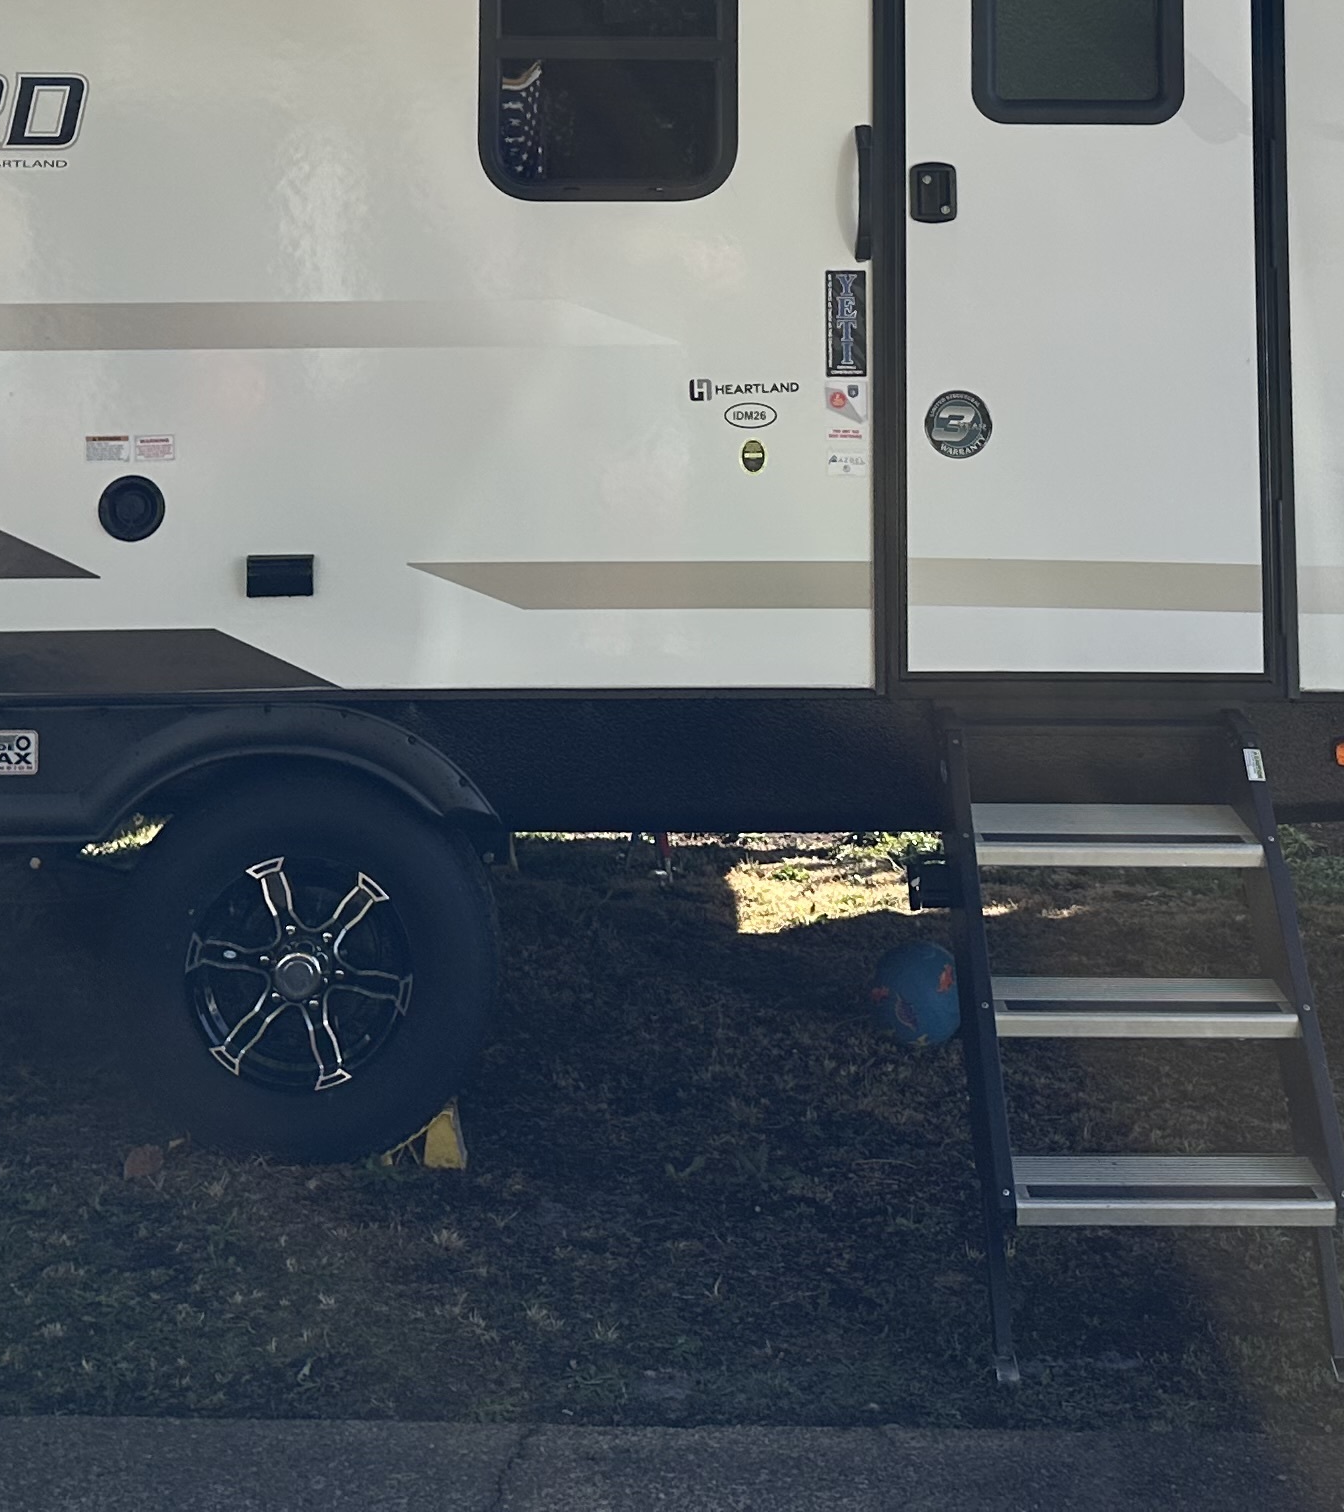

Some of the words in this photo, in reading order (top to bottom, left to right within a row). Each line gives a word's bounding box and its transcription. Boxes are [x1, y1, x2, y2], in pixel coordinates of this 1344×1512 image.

[835, 273, 858, 365] YETI
[715, 382, 800, 395] HEARTLAND
[732, 410, 767, 421] IDM26
[931, 405, 976, 442] 3
[940, 436, 986, 456] WARRANTY
